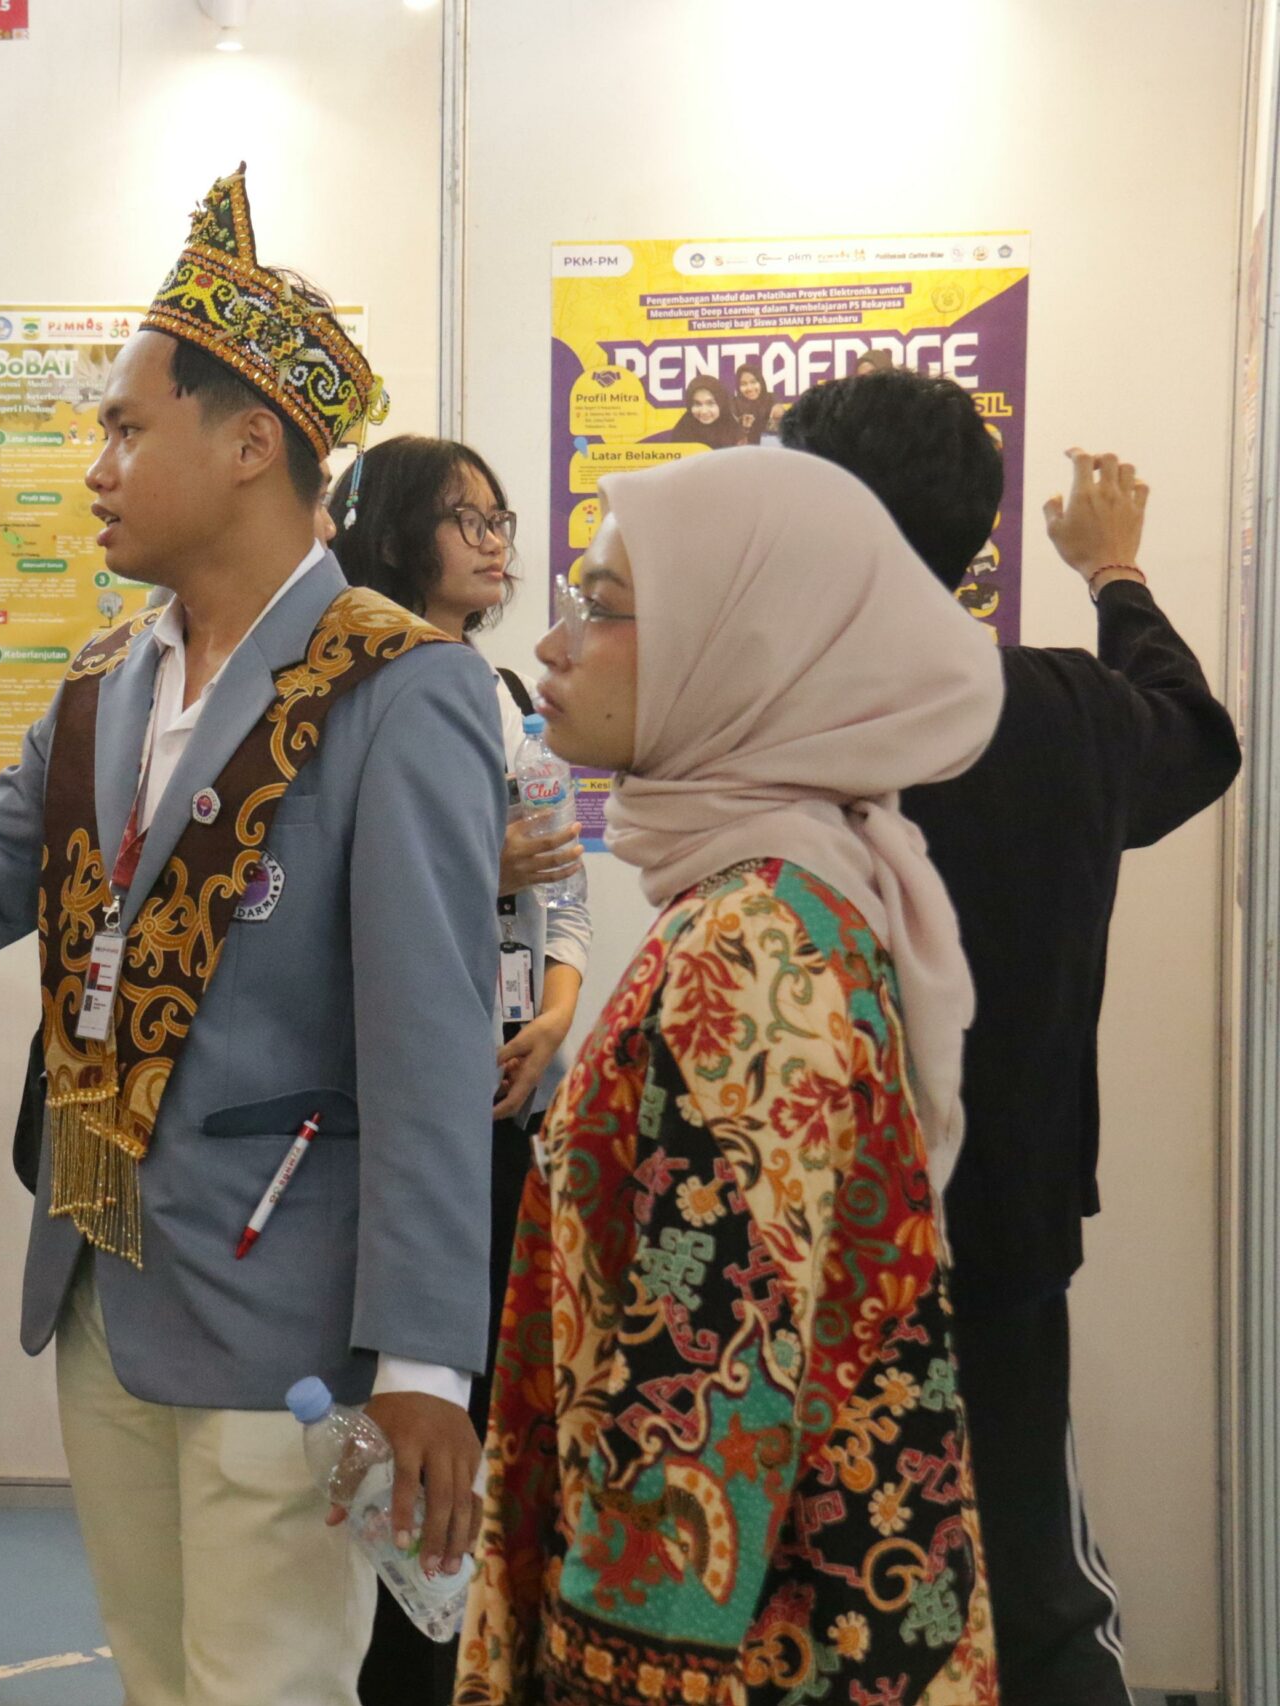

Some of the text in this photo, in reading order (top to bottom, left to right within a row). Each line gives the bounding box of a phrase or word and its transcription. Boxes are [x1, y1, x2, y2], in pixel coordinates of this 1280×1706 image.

[564, 256, 618, 267] PKM-PM
[646, 295, 710, 307] Pengembangan
[711, 293, 738, 303] Modul
[739, 292, 755, 301] dan
[798, 289, 828, 300] Proyek
[829, 287, 877, 297] Elektronika
[879, 285, 905, 294] untuk
[650, 309, 700, 320] Mendukung
[701, 308, 721, 319] Deep
[723, 306, 760, 317] Learning
[761, 304, 788, 313] dalam
[789, 301, 847, 313] Pembelajaran
[861, 299, 901, 310] Rekayasa
[691, 320, 733, 330] Teknologi
[734, 318, 752, 329] bagi
[779, 316, 805, 326] SMAN
[813, 314, 859, 324] Pekanbaru
[575, 393, 640, 403] Profil Mitra
[591, 451, 622, 461] Latar
[98, 575, 105, 584] 3
[526, 779, 560, 800] Club
